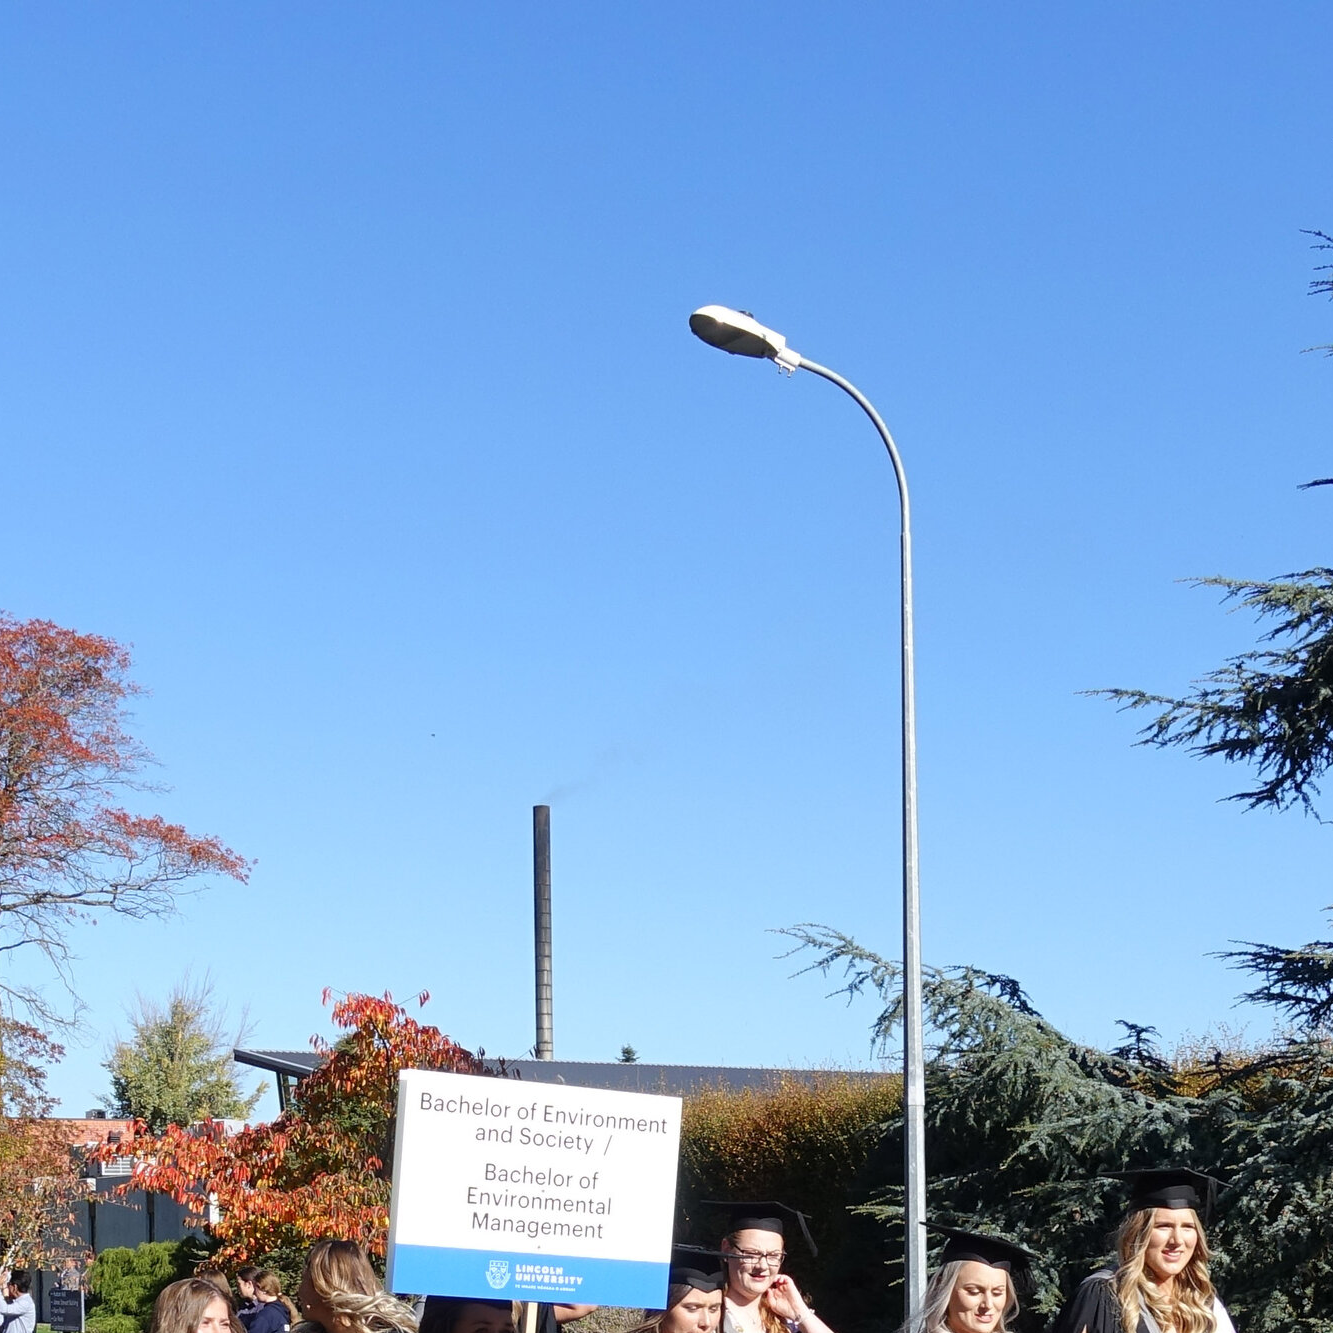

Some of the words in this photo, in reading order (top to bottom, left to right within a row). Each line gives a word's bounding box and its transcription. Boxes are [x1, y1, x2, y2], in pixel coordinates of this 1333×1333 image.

[421, 1093, 510, 1117] Bachelor
[518, 1103, 537, 1120] of
[544, 1105, 667, 1134] Environment
[476, 1126, 512, 1143] and
[520, 1128, 593, 1154] Society
[485, 1163, 573, 1187] Bachelor
[580, 1172, 598, 1189] of
[468, 1186, 611, 1216] Environmental
[472, 1211, 604, 1238] Management
[516, 1264, 563, 1275] LINCOLN
[516, 1274, 583, 1285] UNIVERSITY
